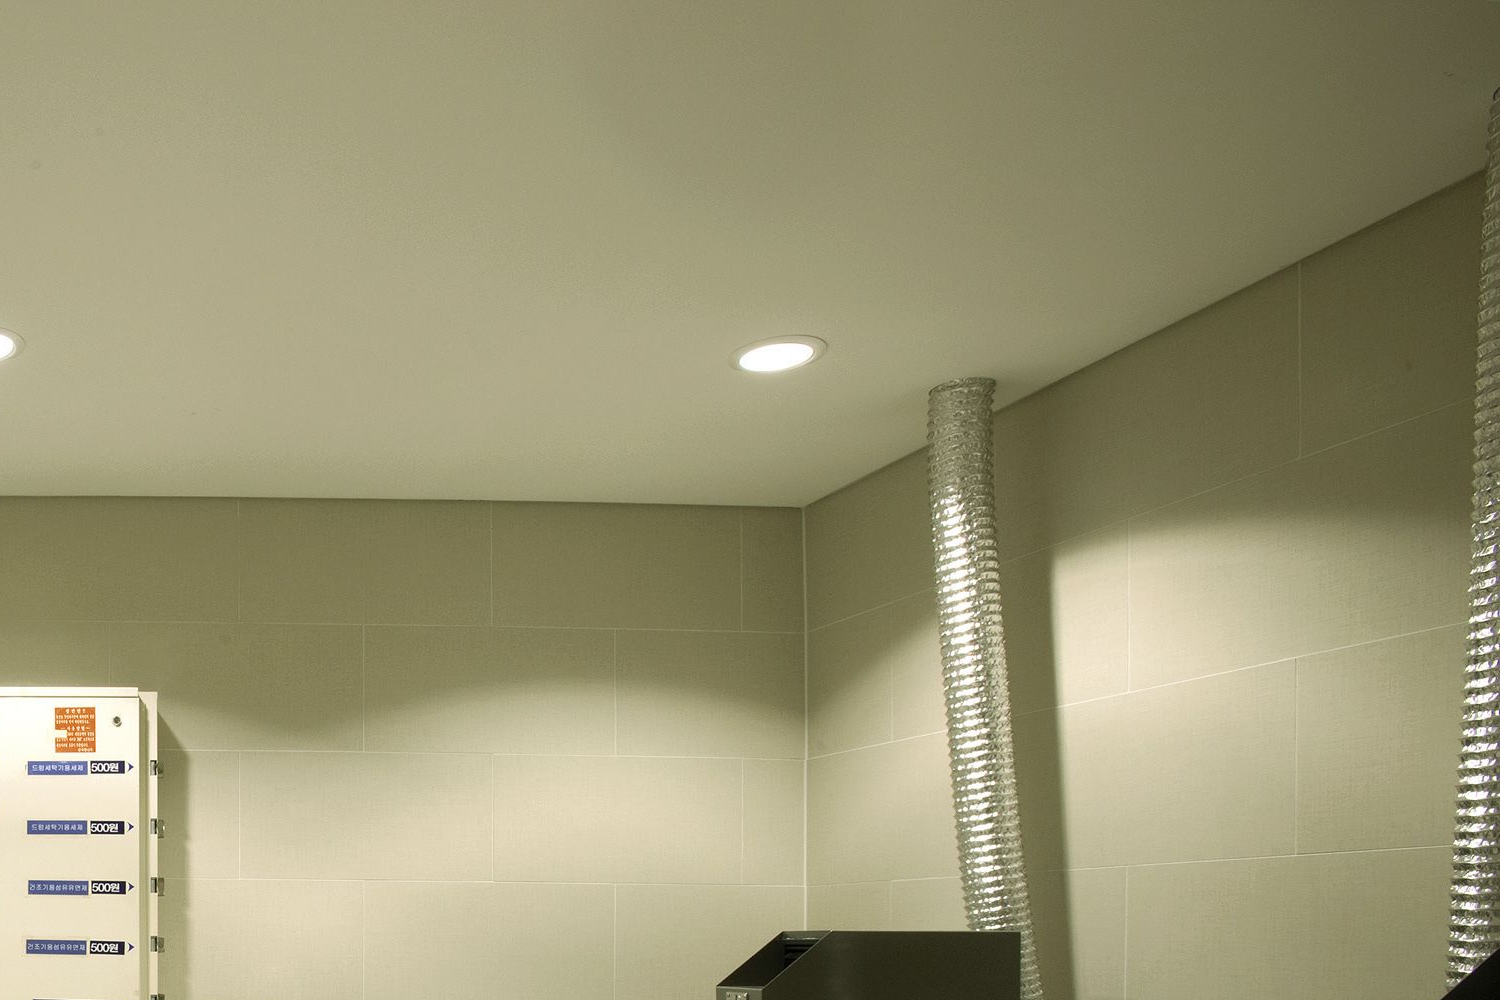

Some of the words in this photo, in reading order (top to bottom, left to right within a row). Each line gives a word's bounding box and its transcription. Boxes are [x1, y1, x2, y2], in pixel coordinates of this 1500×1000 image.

[91, 762, 119, 772] 500원
[91, 823, 119, 832] 500원
[92, 883, 120, 892] 500원
[91, 943, 119, 953] 500원
